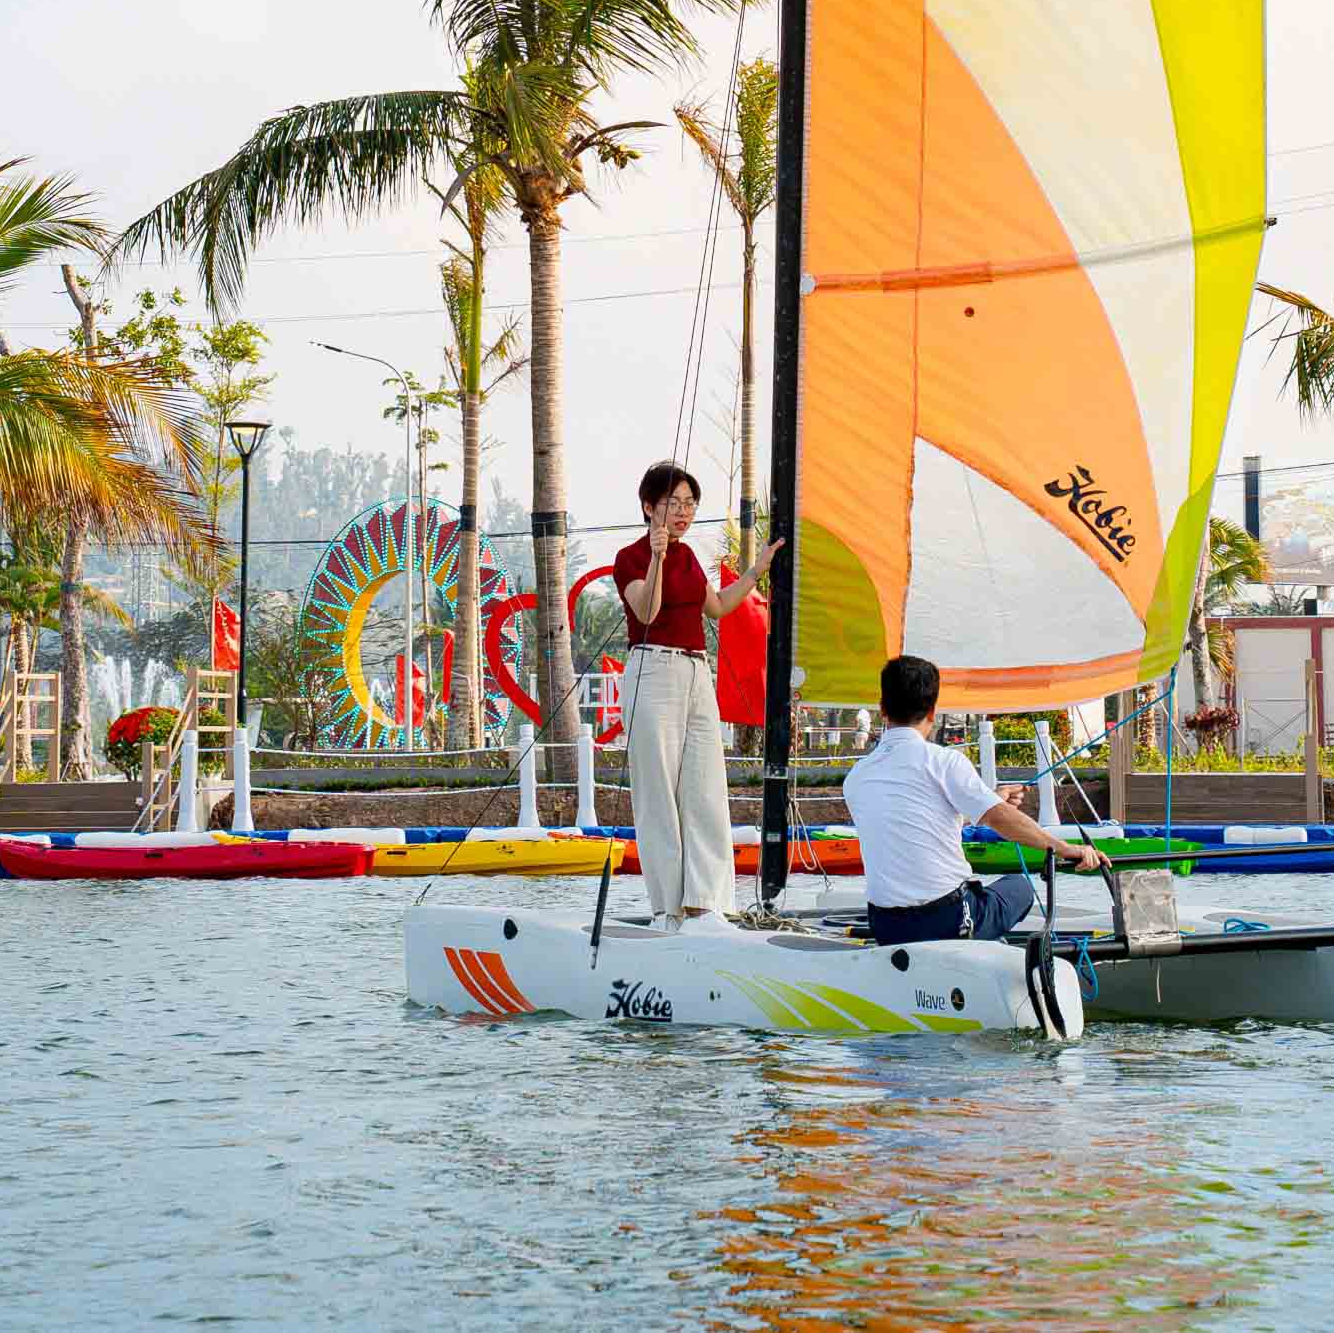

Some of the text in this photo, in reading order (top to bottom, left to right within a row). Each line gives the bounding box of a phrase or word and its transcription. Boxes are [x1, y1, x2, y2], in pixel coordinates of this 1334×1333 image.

[1044, 464, 1136, 562] Hobie
[605, 978, 673, 1022] Hobie
[915, 988, 947, 1011] Wave
